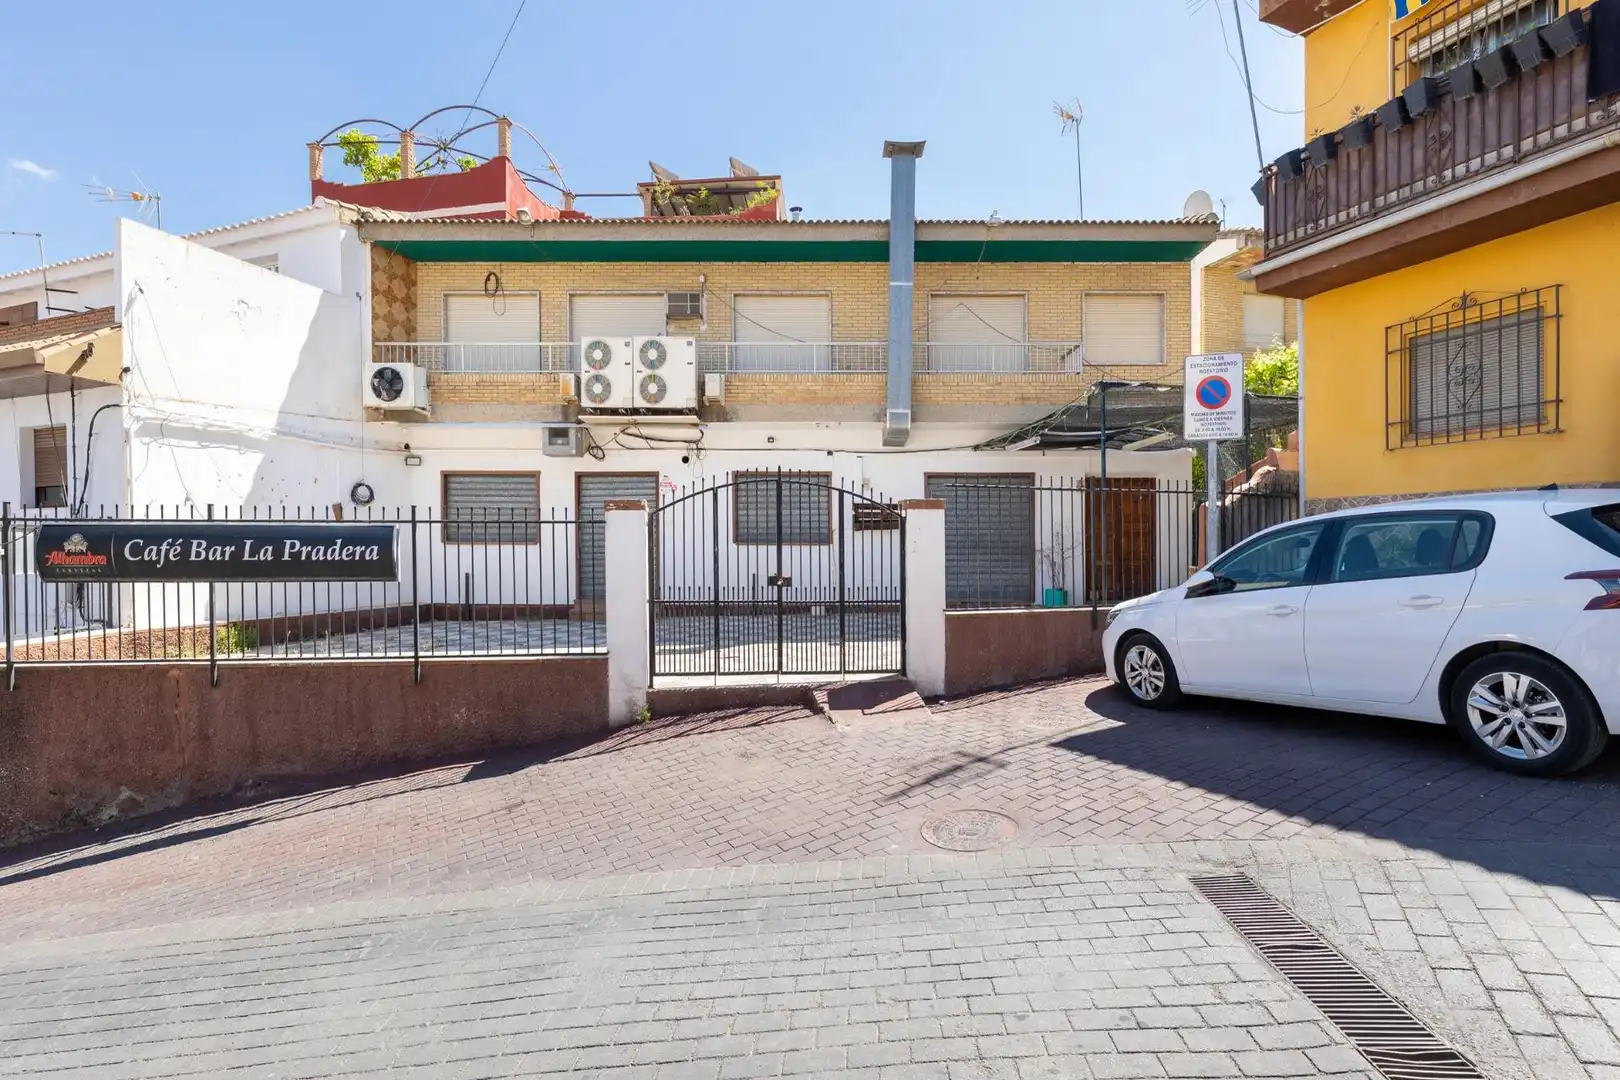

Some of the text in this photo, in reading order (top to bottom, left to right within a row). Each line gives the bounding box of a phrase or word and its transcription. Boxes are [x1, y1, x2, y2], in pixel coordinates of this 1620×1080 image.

[45, 550, 108, 567] Alhambra
[124, 538, 380, 568] Café Bar La Pradera
